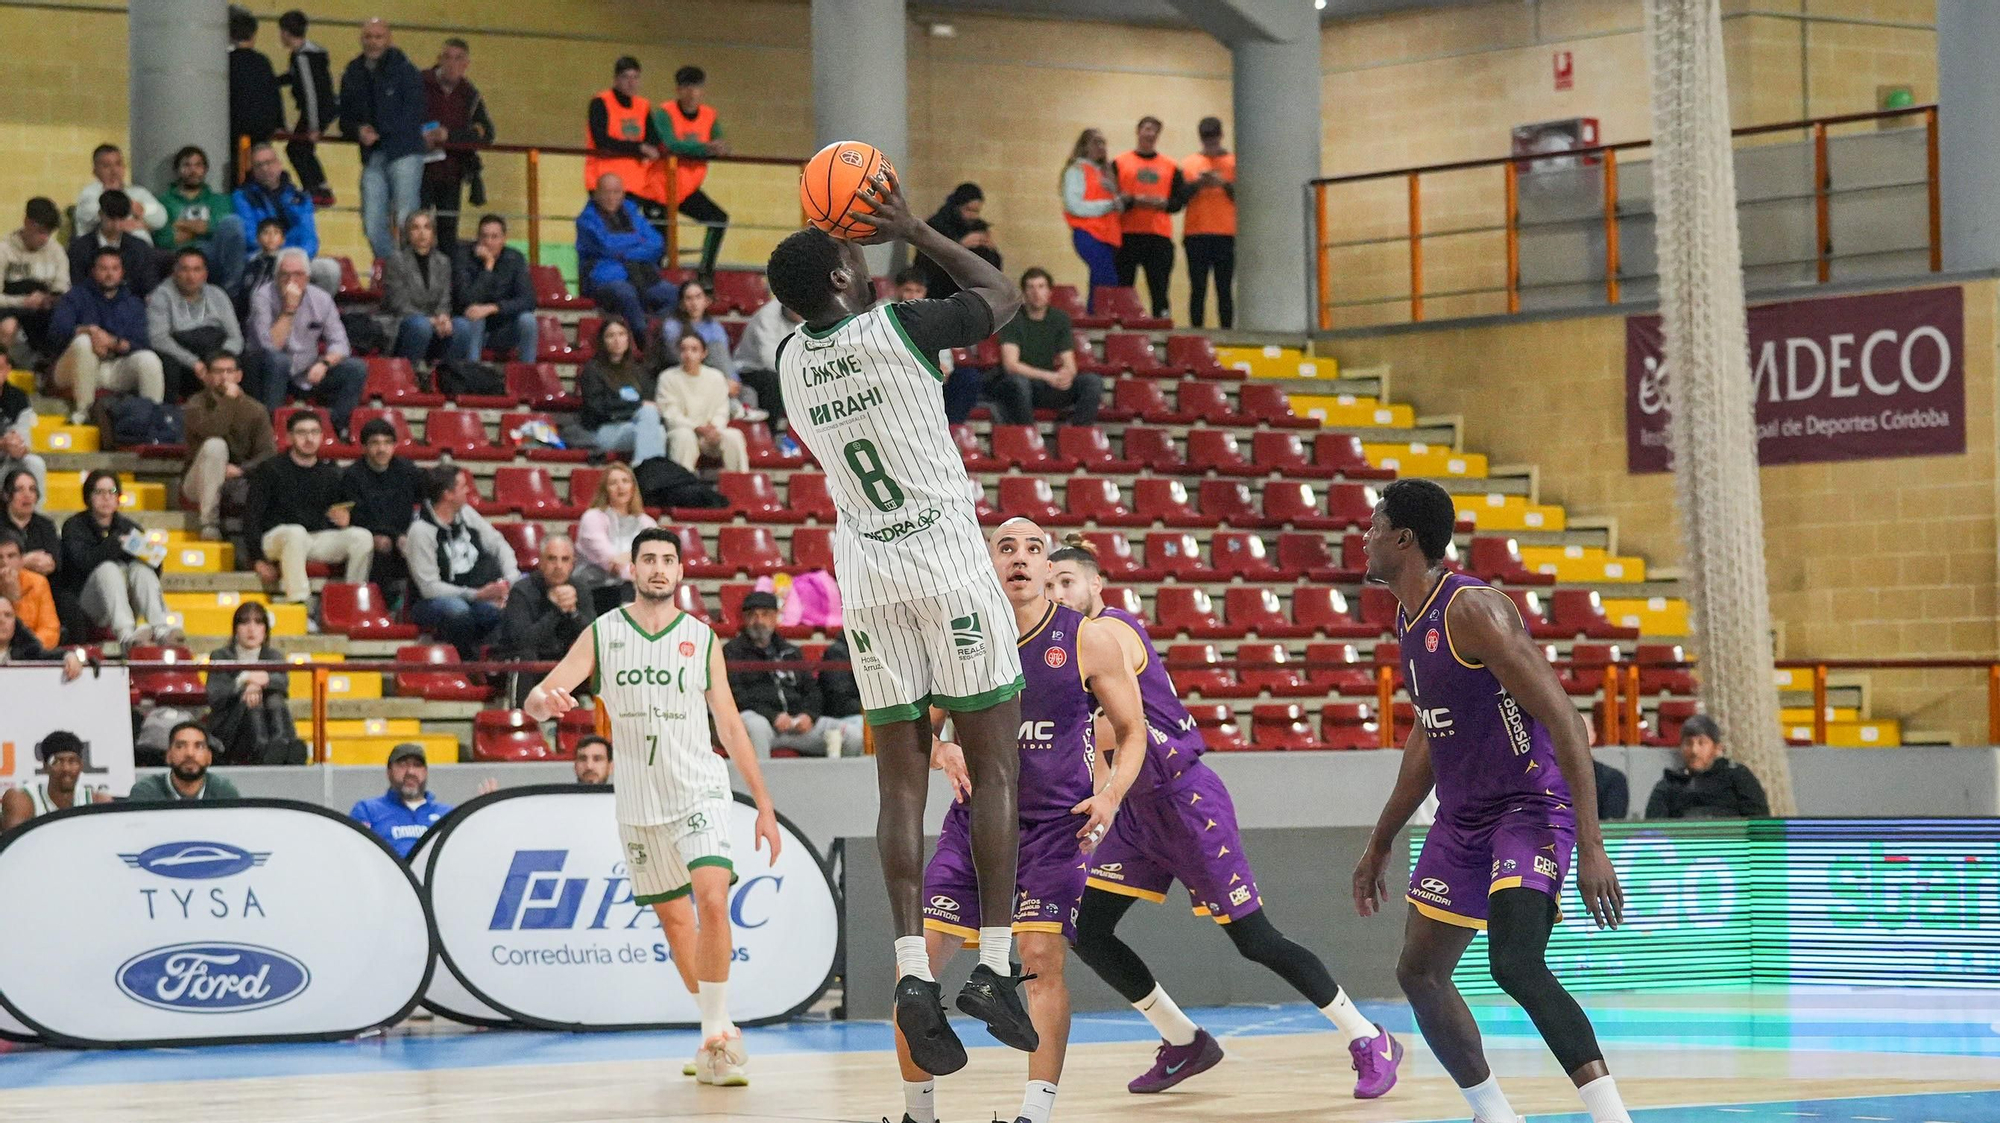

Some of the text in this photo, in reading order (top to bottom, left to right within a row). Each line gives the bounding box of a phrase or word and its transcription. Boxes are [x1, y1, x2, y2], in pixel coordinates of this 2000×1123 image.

[803, 354, 861, 387] LAMINE
[1751, 326, 1951, 402] MDECO
[831, 386, 883, 419] RAHI
[1781, 418, 1802, 436] de
[1805, 414, 1878, 438] Deportes
[1880, 407, 1950, 431] Córdoba
[844, 439, 905, 512] 8
[957, 643, 986, 656] REALE
[959, 649, 987, 661] SEGUROS
[616, 665, 672, 687] coto
[1409, 659, 1419, 697] 1
[654, 708, 687, 721] Cajasol
[1504, 697, 1531, 754] aspasia
[646, 735, 658, 766] 7
[1534, 855, 1558, 876] CBC
[140, 886, 266, 920] TYSA
[1228, 885, 1251, 903] CBC
[1411, 887, 1452, 906] HYUNDAI
[923, 906, 961, 923] HYUNDAI
[491, 944, 613, 966] Correduria
[618, 943, 648, 965] de
[156, 953, 271, 1001] Ford
